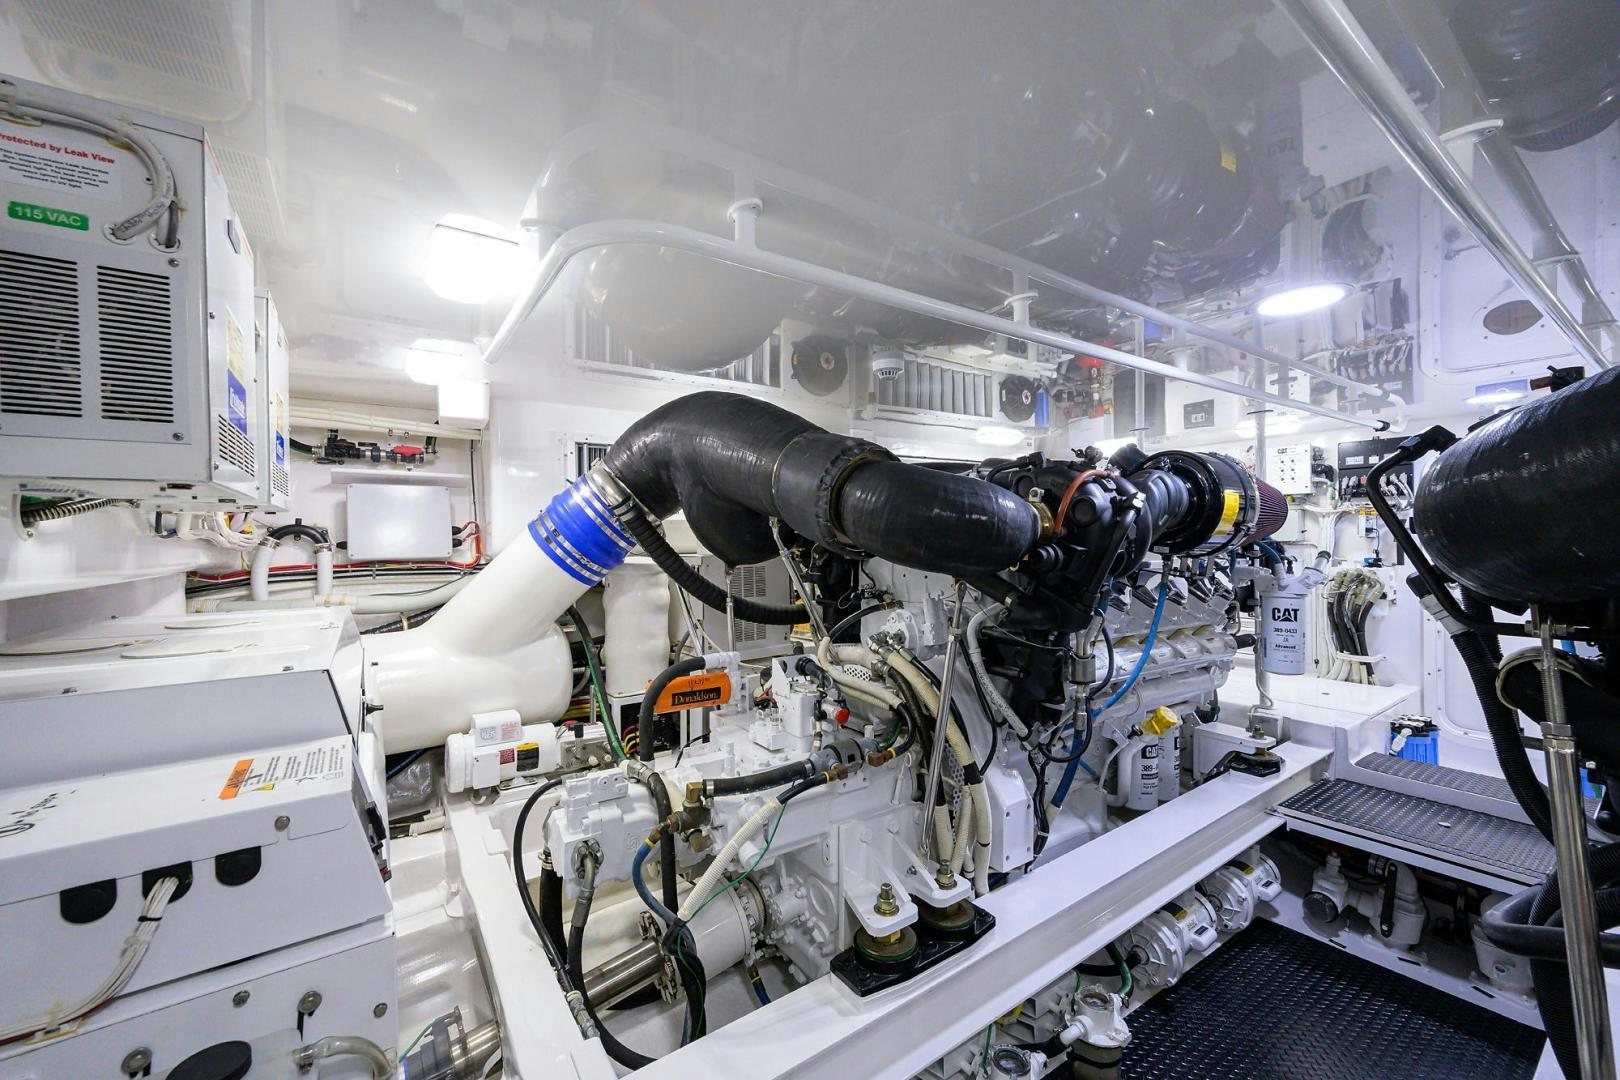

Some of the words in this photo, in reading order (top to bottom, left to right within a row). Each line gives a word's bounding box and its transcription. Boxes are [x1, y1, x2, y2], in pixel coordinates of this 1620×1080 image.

[49, 143, 62, 154] by
[65, 147, 89, 159] Leak
[91, 152, 116, 164] View
[14, 206, 43, 220] 115
[46, 211, 81, 226] VAC
[1271, 607, 1300, 623] CAT
